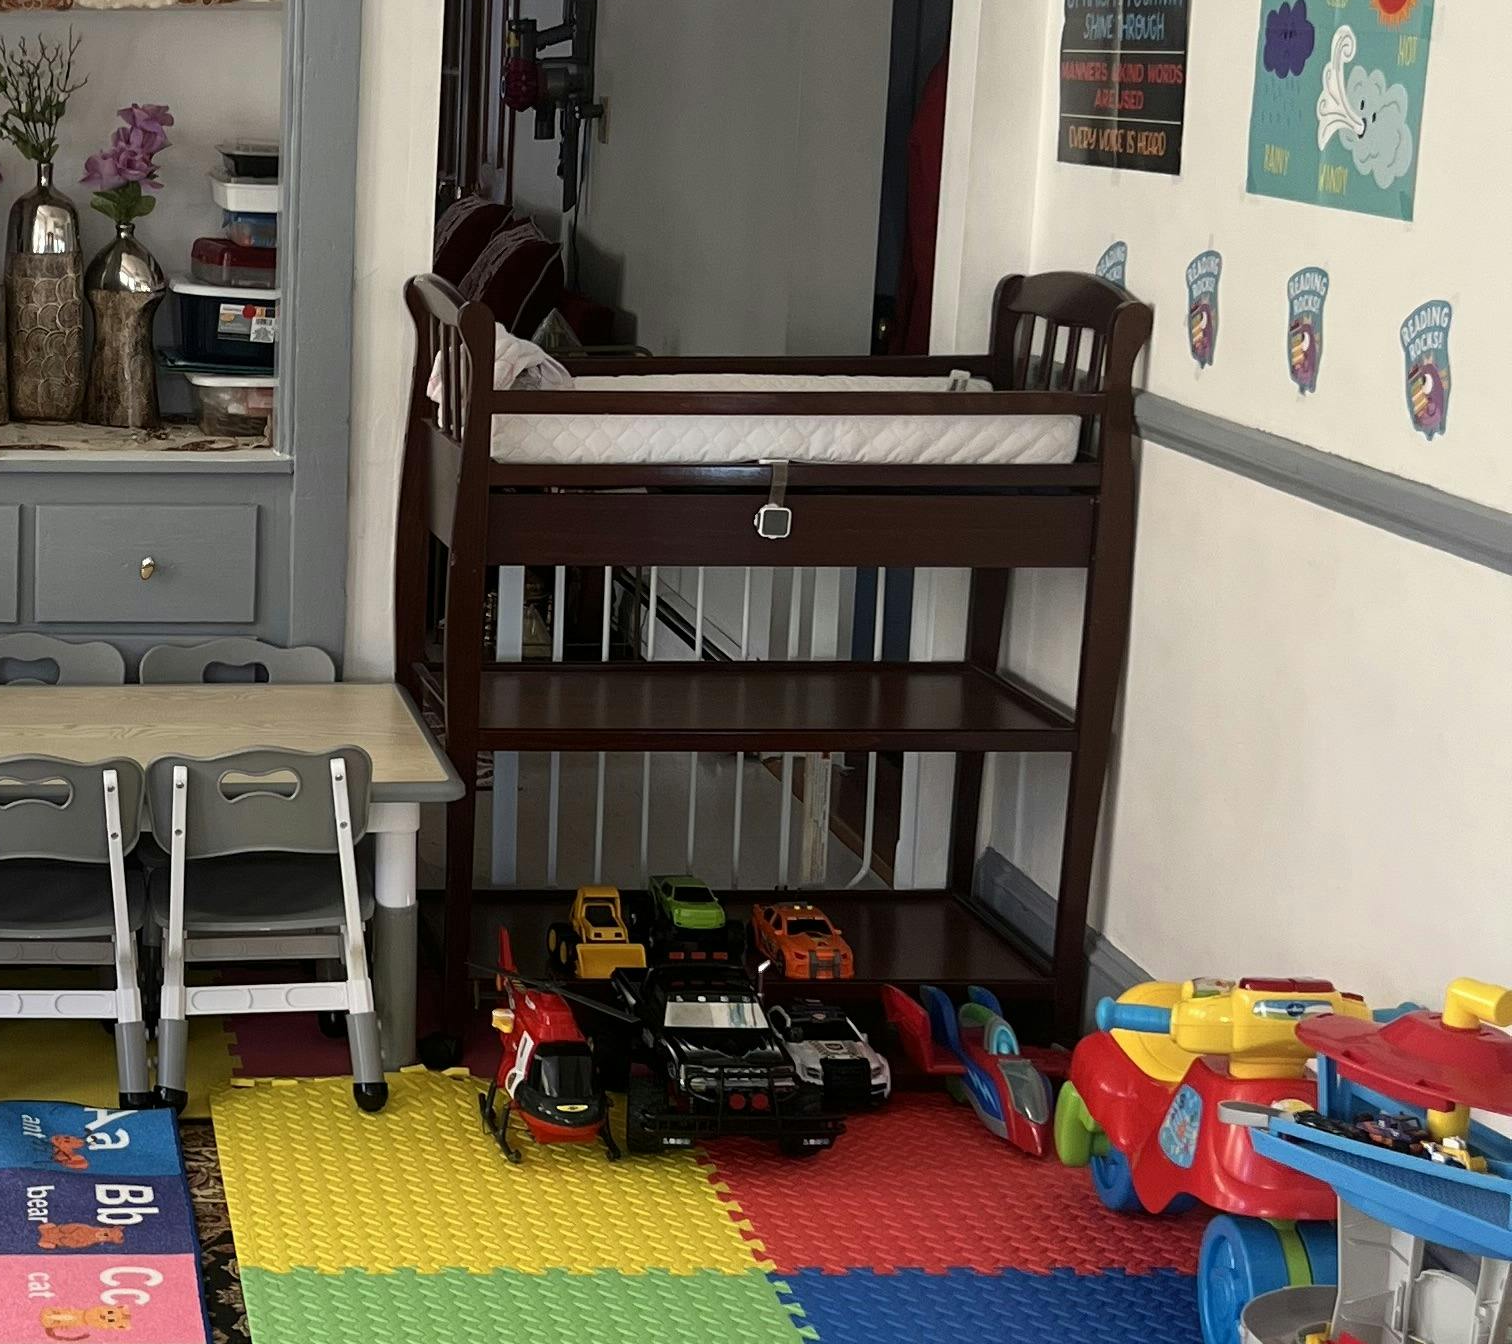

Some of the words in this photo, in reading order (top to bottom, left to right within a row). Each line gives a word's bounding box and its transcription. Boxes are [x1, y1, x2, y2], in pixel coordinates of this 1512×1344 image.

[1289, 272, 1328, 299] READING
[1402, 307, 1450, 346] READING
[1408, 332, 1443, 360] ROCKS!
[25, 1185, 56, 1224] bear
[93, 1183, 161, 1226] Bb
[27, 1271, 57, 1300] cat
[99, 1265, 164, 1308] Cc
